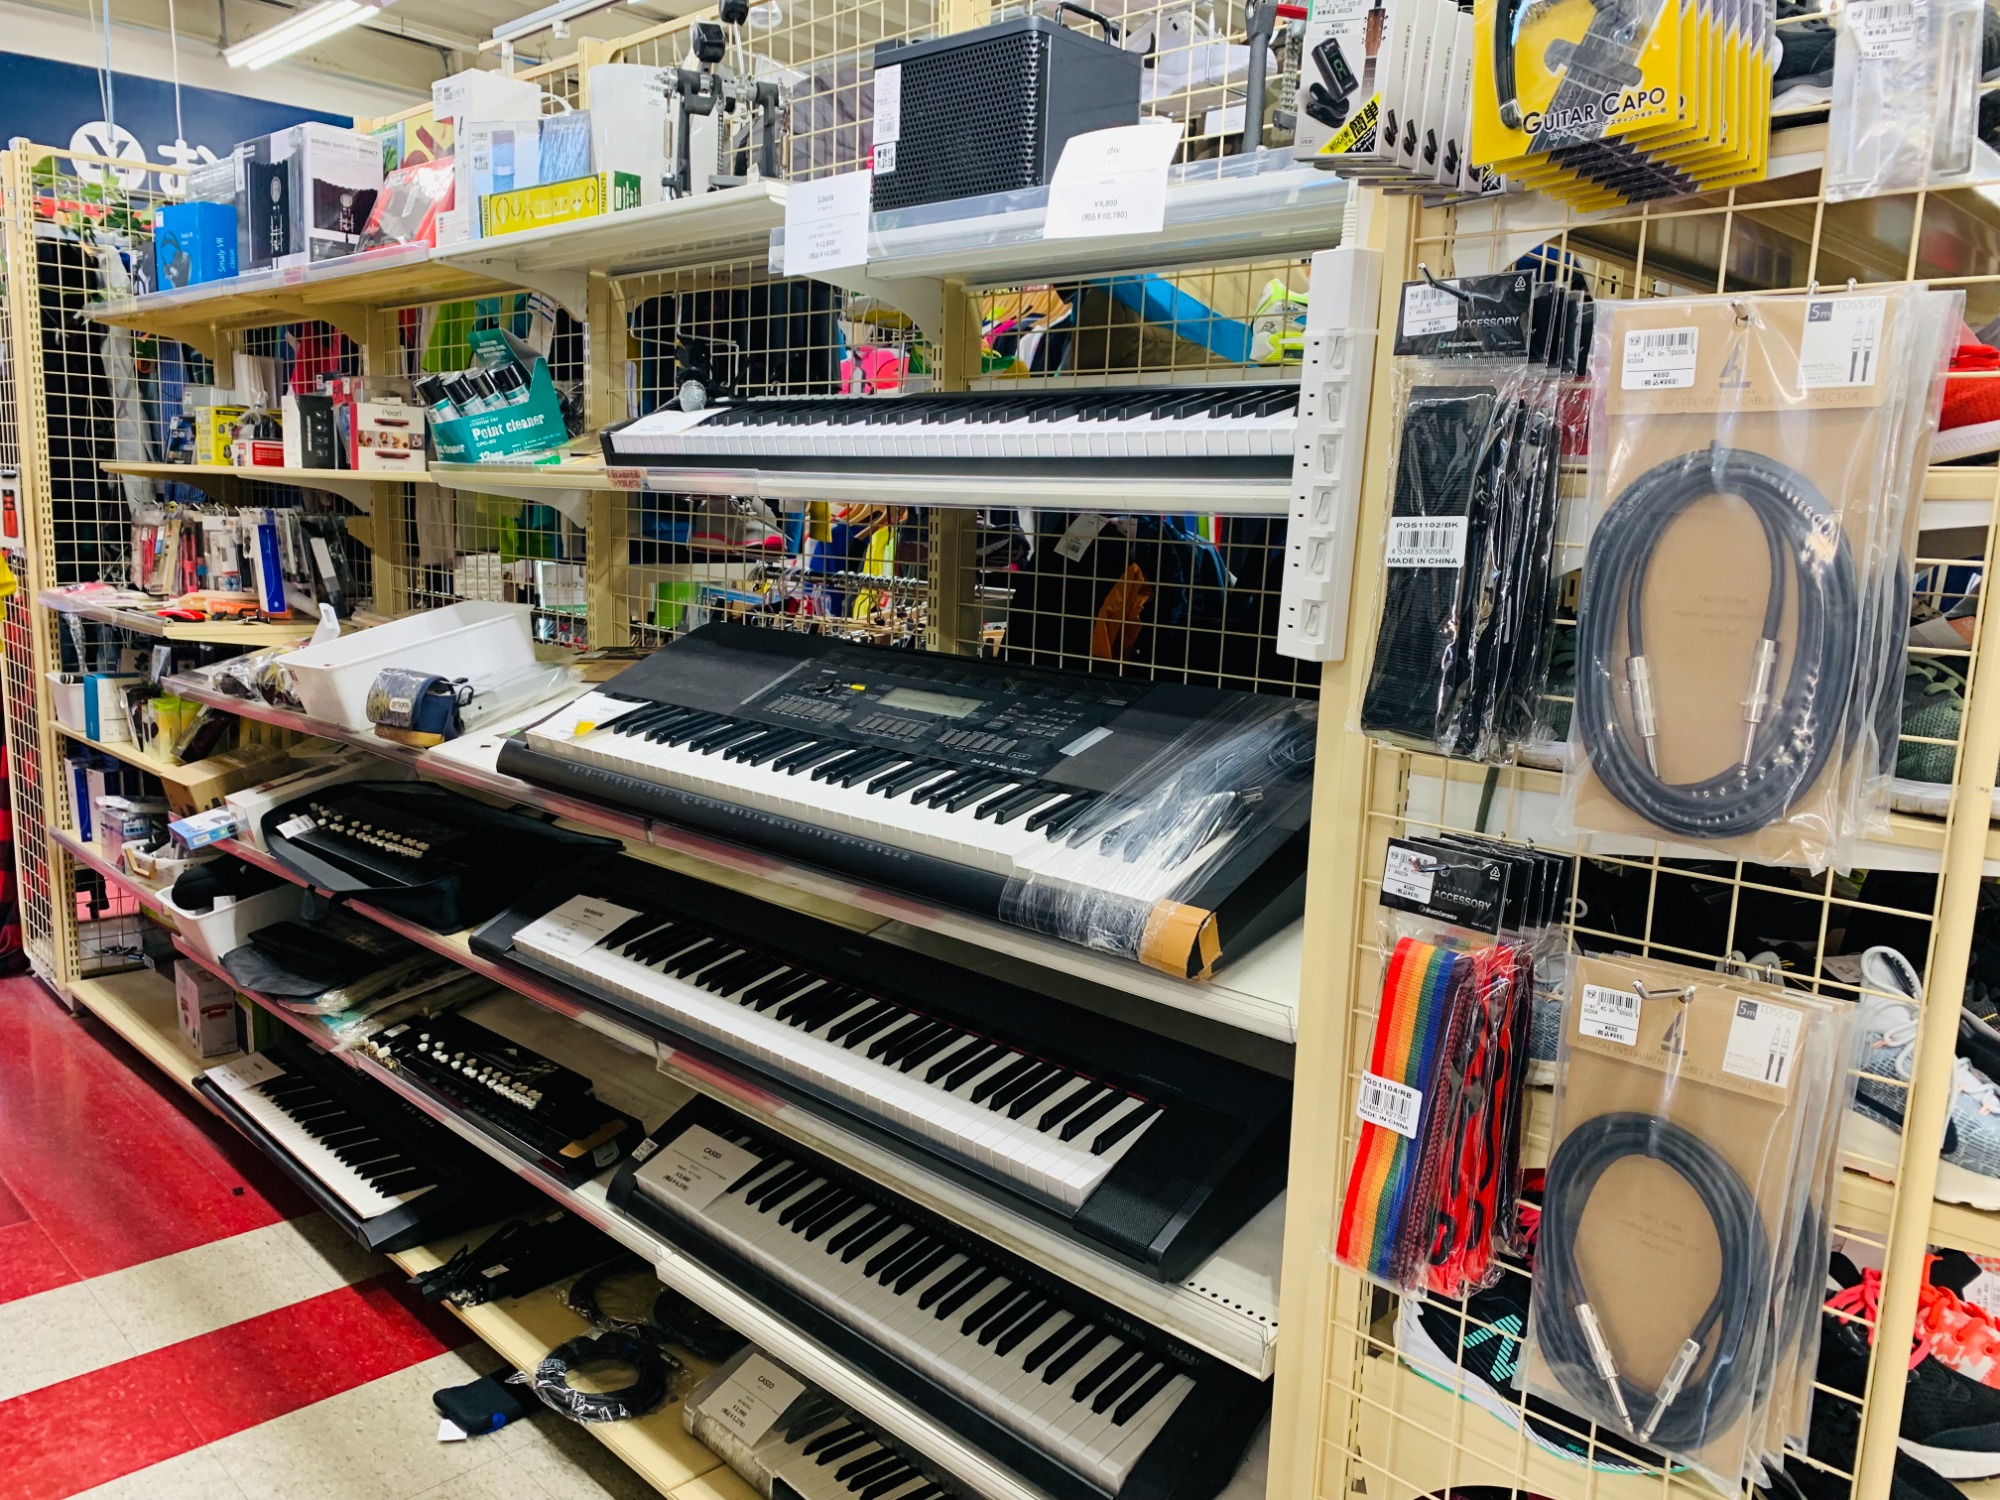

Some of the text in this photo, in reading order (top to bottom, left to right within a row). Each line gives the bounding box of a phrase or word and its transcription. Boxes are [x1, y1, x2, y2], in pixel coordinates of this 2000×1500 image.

[1523, 87, 1666, 134] GUITAR CAPO
[1349, 100, 1379, 139] 簡単
[311, 138, 331, 147] SOUND
[353, 146, 378, 156] COMPACT
[1107, 146, 1120, 155] dw
[818, 193, 834, 203] Louis
[1094, 199, 1118, 208] ¥9,800
[216, 236, 226, 274] Smaly VR
[1810, 305, 1831, 320] 5m
[1457, 316, 1520, 329] ACCESSORY
[1642, 378, 1680, 386] (税込¥968)
[1740, 394, 1774, 406] CABLE
[382, 408, 403, 417] Pearl
[472, 414, 544, 440] Point cleaner
[1434, 890, 1492, 911] ACCESSORY
[1738, 1003, 1756, 1018] 5m
[1760, 1004, 1799, 1022] TDSS-05
[1576, 1036, 1612, 1051] MUSICAL
[1364, 1076, 1412, 1099] PGS1104/RB
[1360, 1107, 1377, 1118] MADE
[1388, 1118, 1409, 1130] CHINA
[703, 1147, 722, 1160] CASIO
[757, 1375, 775, 1390] CASIO
